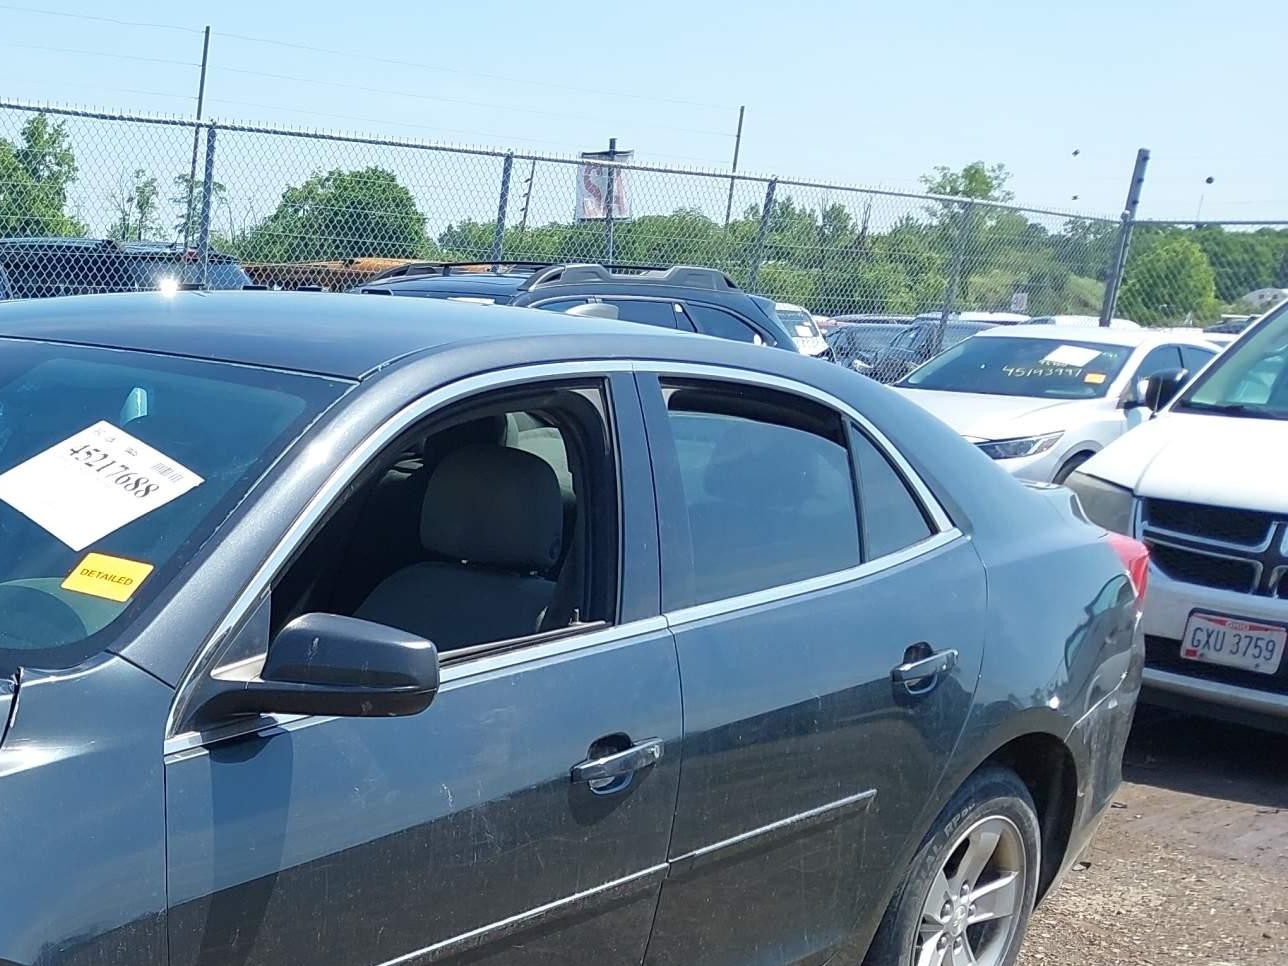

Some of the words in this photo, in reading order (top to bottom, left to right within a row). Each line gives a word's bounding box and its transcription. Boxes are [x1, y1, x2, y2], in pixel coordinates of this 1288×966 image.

[68, 444, 160, 498] 45217688
[79, 567, 134, 586] DETAILED
[1191, 627, 1226, 652] GXU
[1229, 633, 1277, 661] 3759
